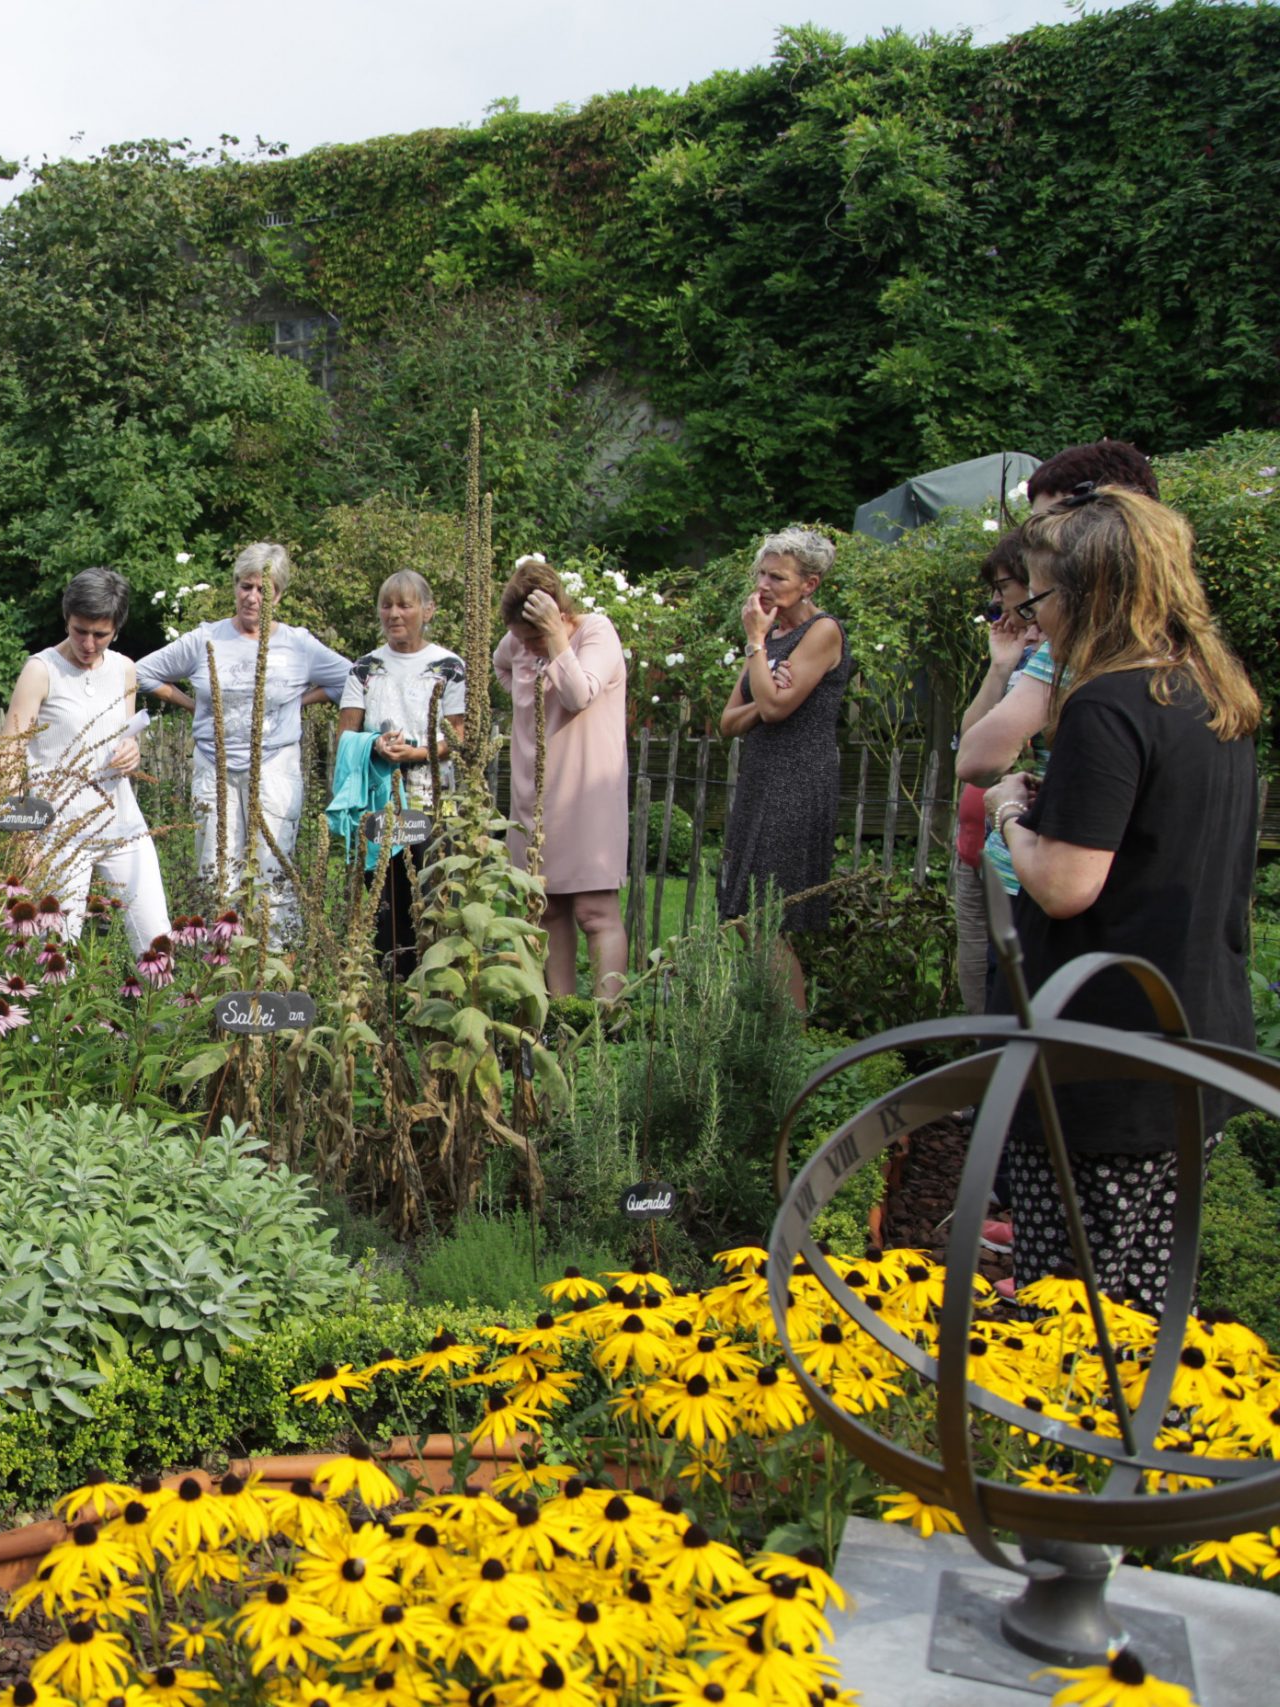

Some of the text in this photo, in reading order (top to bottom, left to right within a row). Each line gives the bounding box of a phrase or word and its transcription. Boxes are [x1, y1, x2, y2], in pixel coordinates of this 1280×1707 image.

[222, 1000, 275, 1027] Salbei
[878, 1101, 908, 1139] IX
[824, 1133, 861, 1179] VIII
[626, 1191, 671, 1211] Quendel
